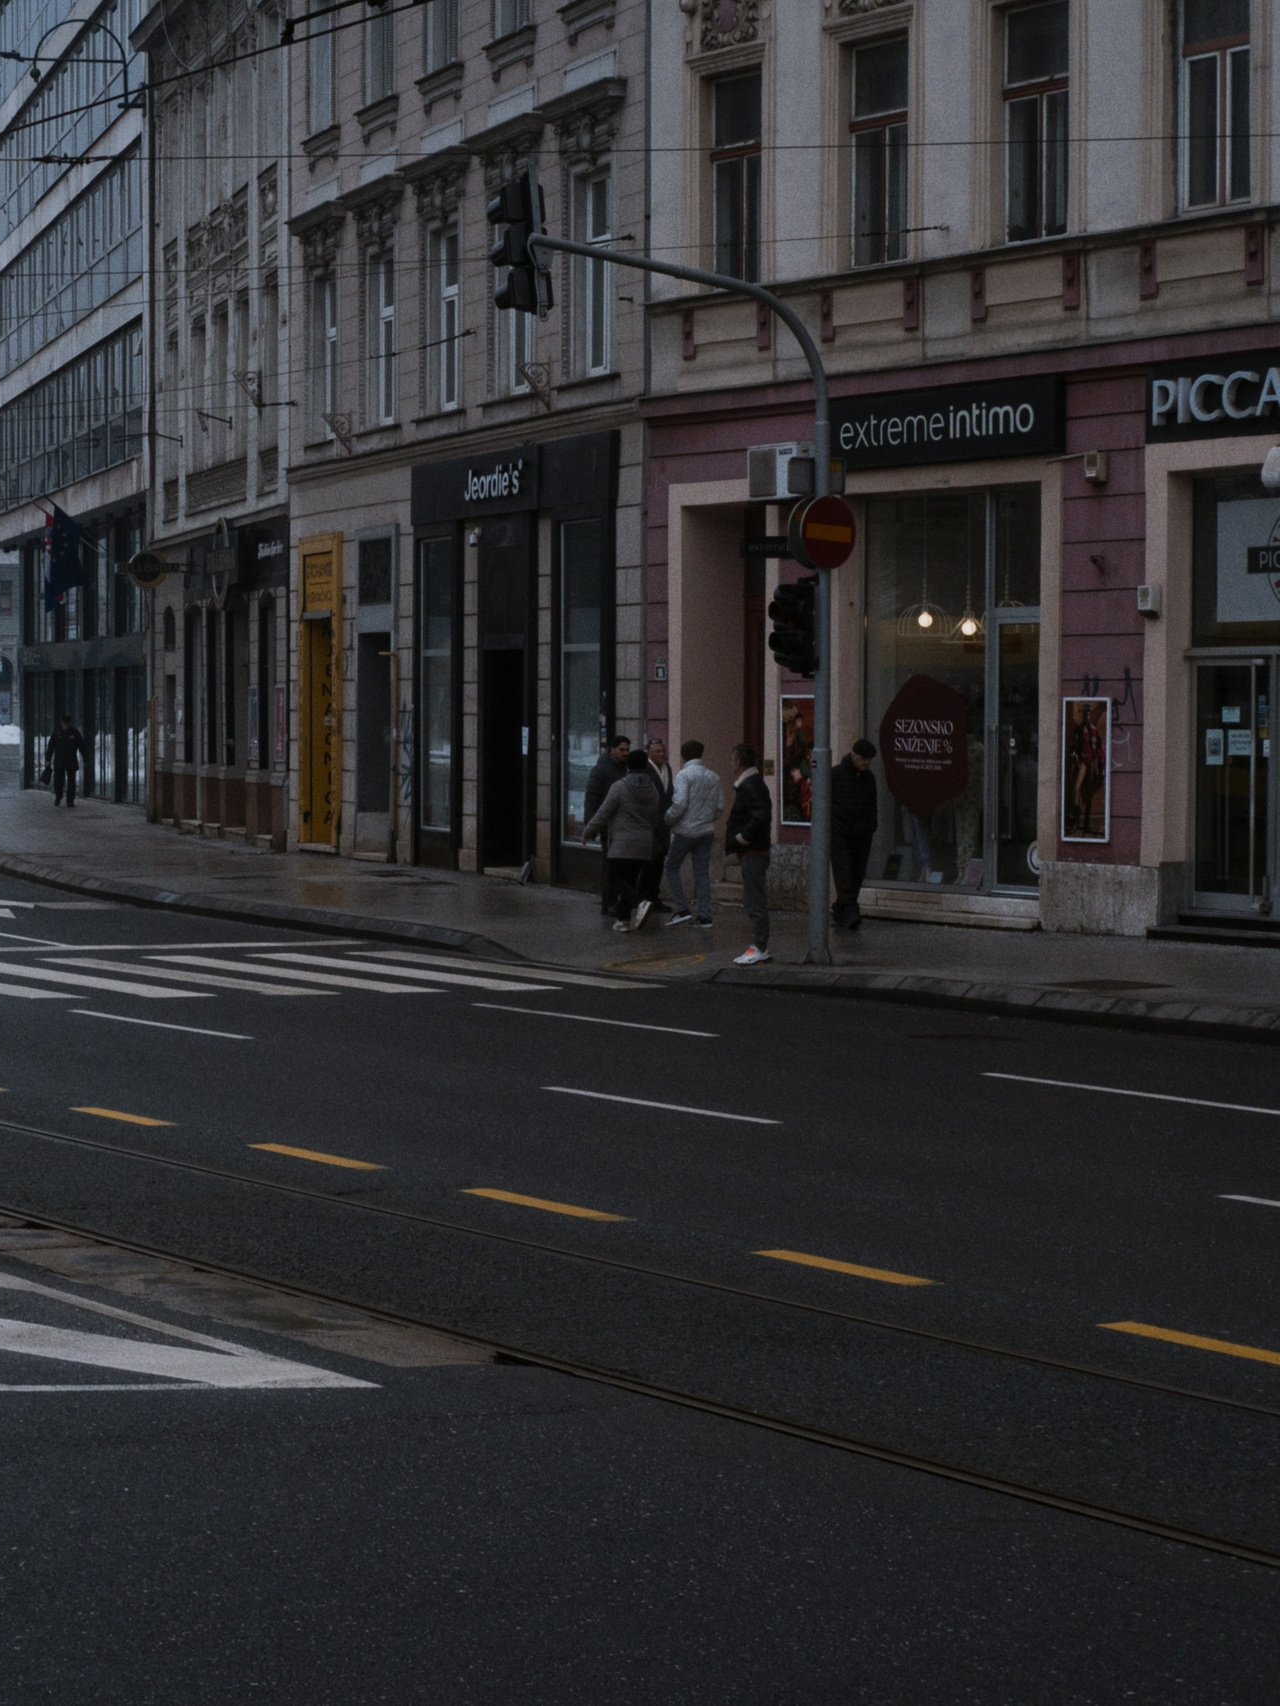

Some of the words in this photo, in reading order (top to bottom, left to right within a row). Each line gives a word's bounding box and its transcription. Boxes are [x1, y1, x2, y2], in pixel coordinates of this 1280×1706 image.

[839, 413, 946, 450] extreme
[948, 401, 1034, 440] intimo
[894, 718, 954, 735] SEZONSKO
[894, 735, 942, 755] SNIŽENJE
